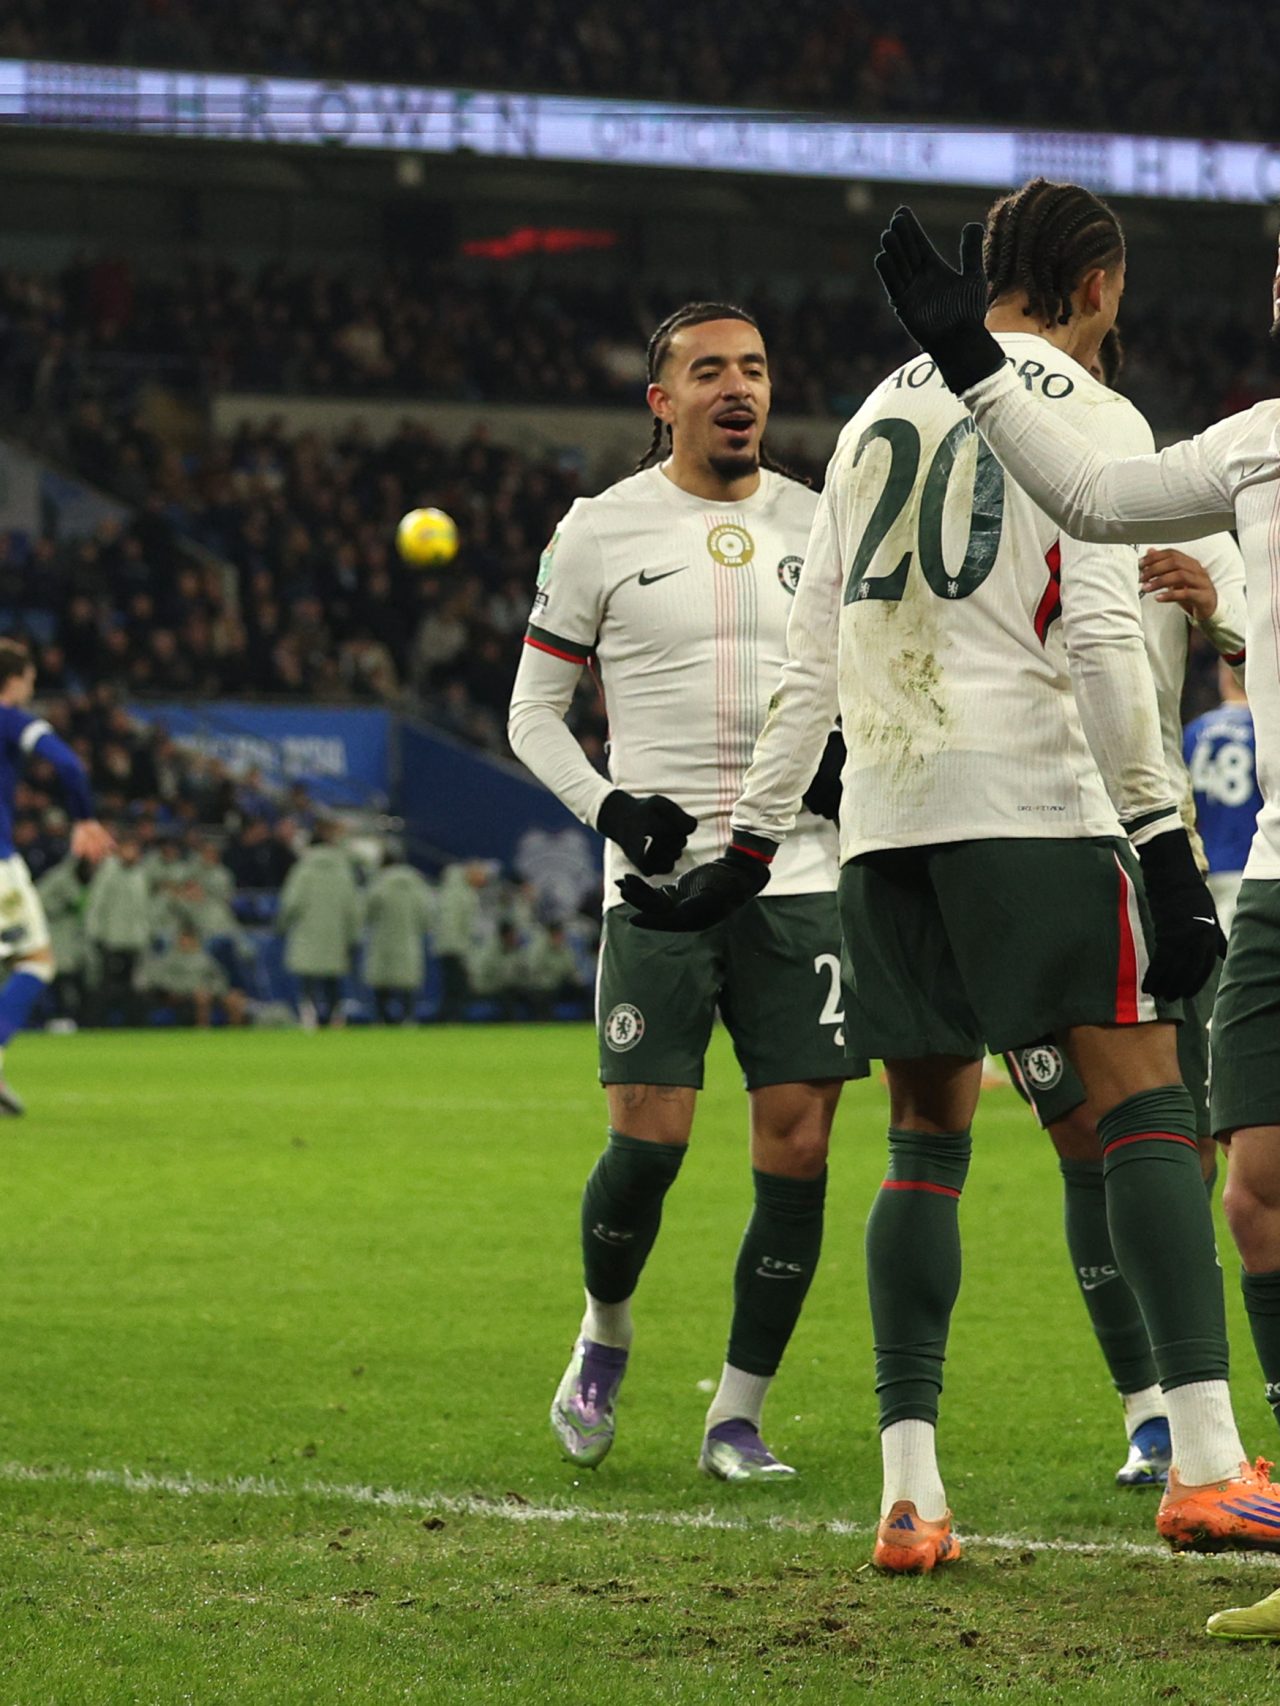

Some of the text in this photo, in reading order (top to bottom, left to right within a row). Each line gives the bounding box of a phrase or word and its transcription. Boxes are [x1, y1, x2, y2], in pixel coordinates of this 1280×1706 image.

[843, 415, 1005, 606] 20
[1190, 739, 1254, 807] 48
[814, 953, 845, 1025] 2
[762, 1256, 802, 1272] CFC
[1079, 1264, 1116, 1278] CFC
